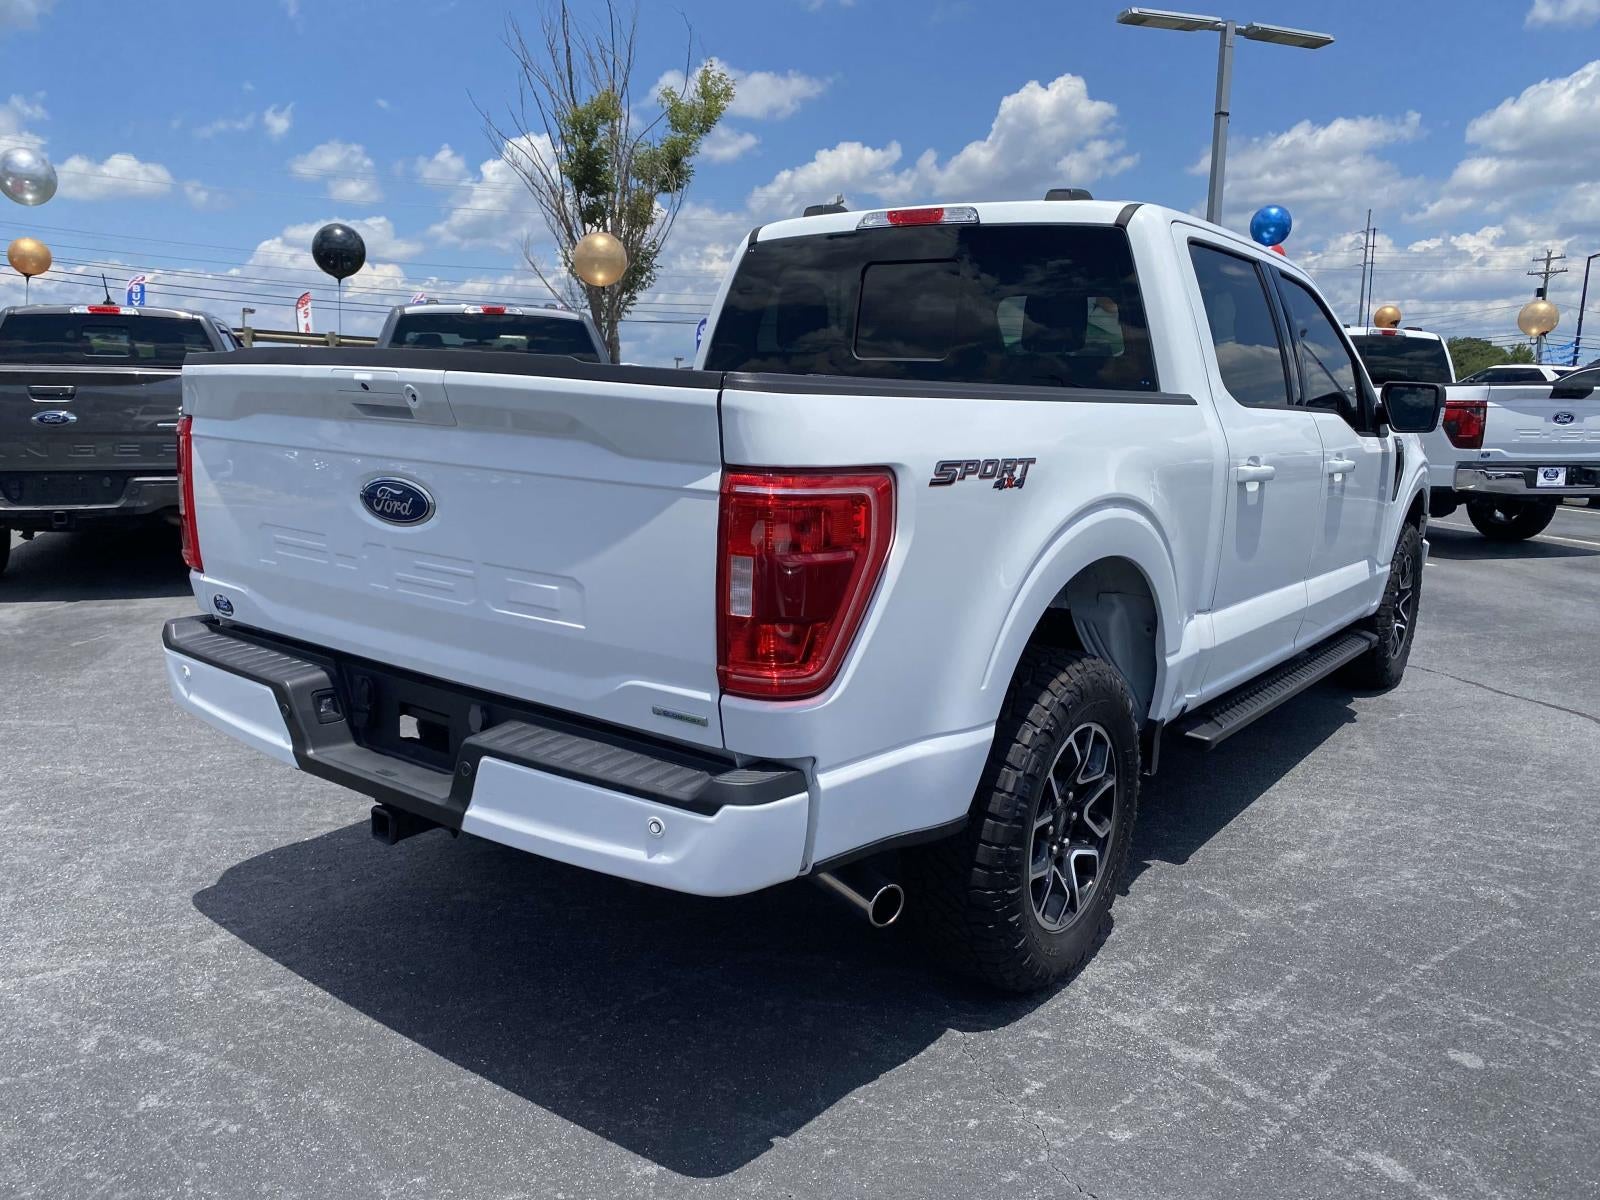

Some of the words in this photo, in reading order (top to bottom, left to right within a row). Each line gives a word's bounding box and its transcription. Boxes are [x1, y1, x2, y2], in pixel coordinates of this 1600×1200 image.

[928, 457, 1037, 487] SPORT
[373, 486, 413, 516] Ford
[257, 522, 586, 629] F-150
